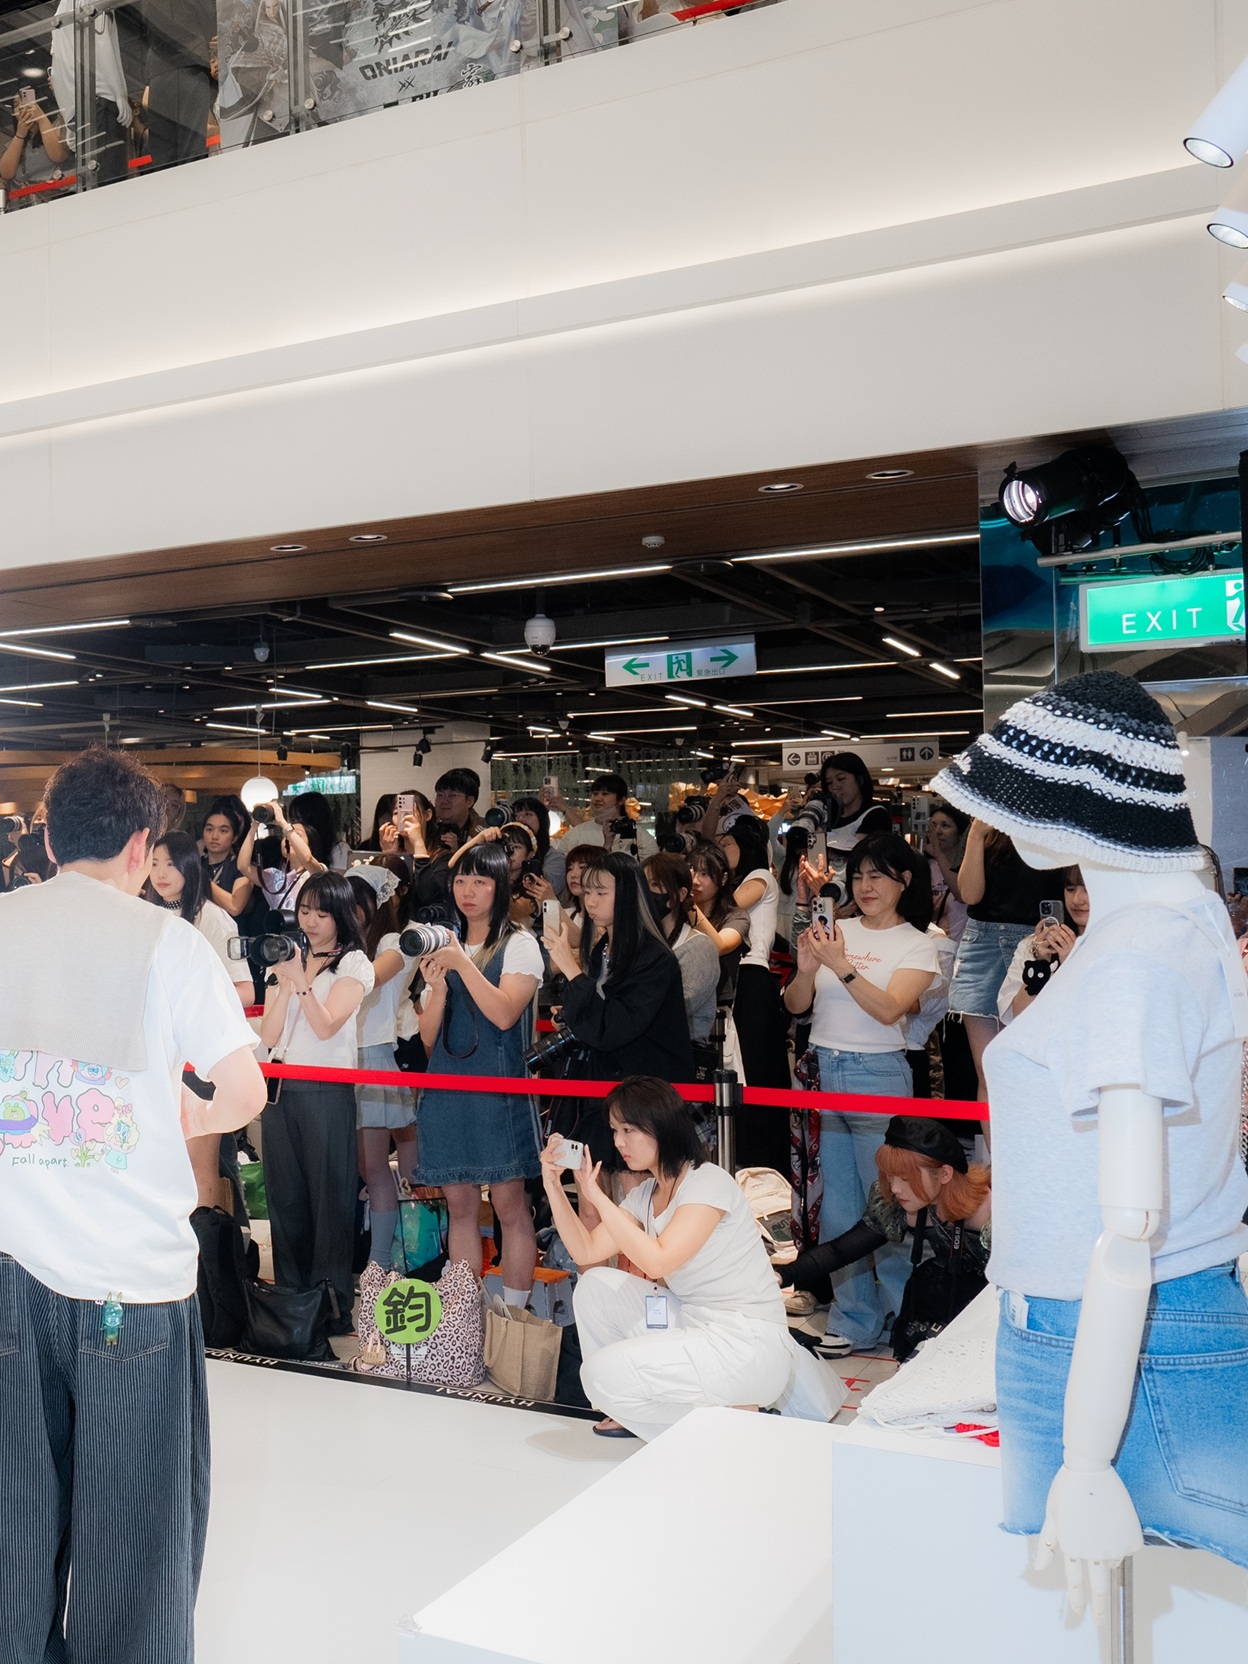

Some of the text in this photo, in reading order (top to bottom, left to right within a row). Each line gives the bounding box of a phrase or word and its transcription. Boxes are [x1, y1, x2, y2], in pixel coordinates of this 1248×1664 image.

[1122, 608, 1202, 634] EXIT
[640, 672, 663, 682] EXIT
[697, 667, 726, 677] 緊急出口
[12, 1153, 36, 1167] Fall
[382, 1285, 431, 1333] 鈞
[436, 1386, 535, 1407] HYUNDAI
